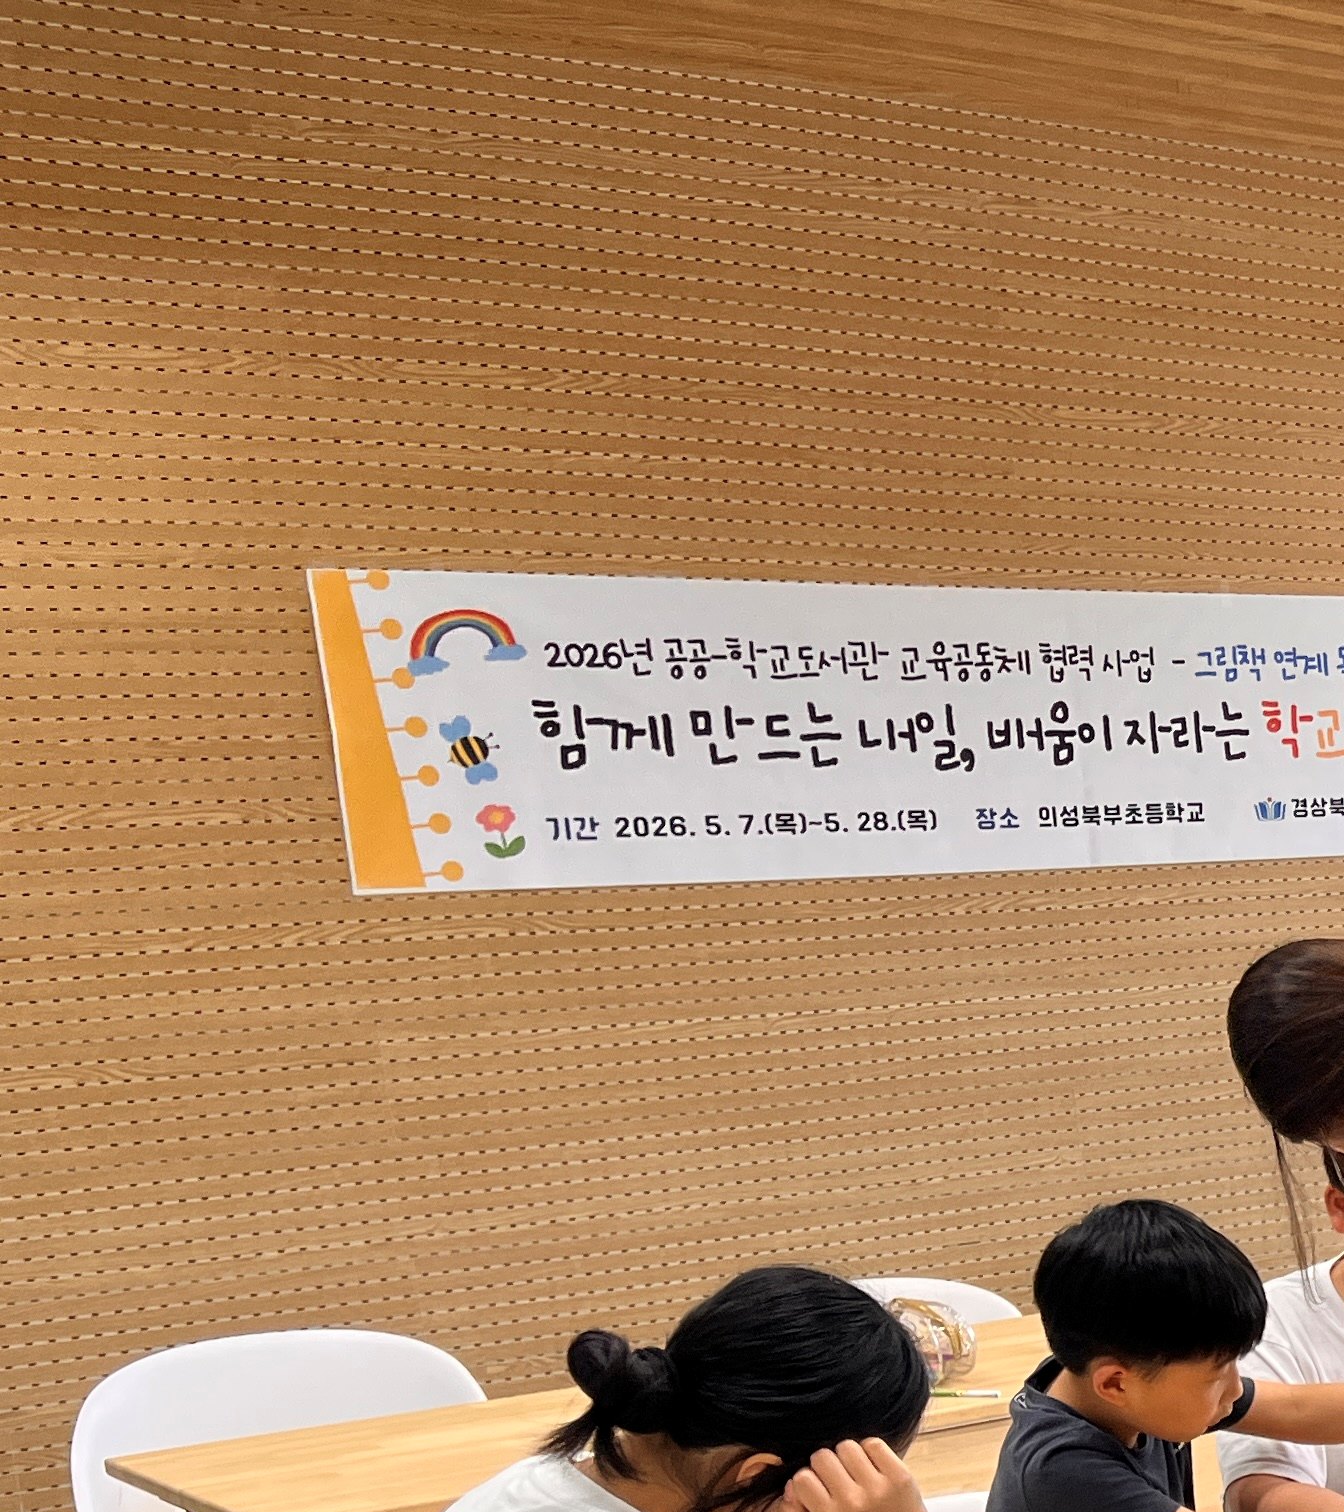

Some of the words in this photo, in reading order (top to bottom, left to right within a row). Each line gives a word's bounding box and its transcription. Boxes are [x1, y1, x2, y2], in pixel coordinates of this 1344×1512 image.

[543, 637, 654, 677] 2026년
[900, 640, 1032, 683] 교육공동체
[1038, 642, 1095, 684] 협력
[1102, 646, 1155, 684] 사업
[1194, 644, 1266, 683] 그림책
[1273, 646, 1329, 681] 연계
[531, 699, 676, 771] 함께
[688, 701, 843, 768] 만드는
[858, 703, 976, 773] 내일,
[986, 700, 1113, 767] 배움이
[1123, 701, 1250, 761] 자라는
[545, 816, 600, 841] 기간
[614, 815, 696, 838] 2026.
[704, 814, 731, 836] 5.
[857, 809, 938, 832] 28.(목)
[975, 807, 1020, 830] 장소
[1038, 802, 1206, 828] 의성북부초등학교
